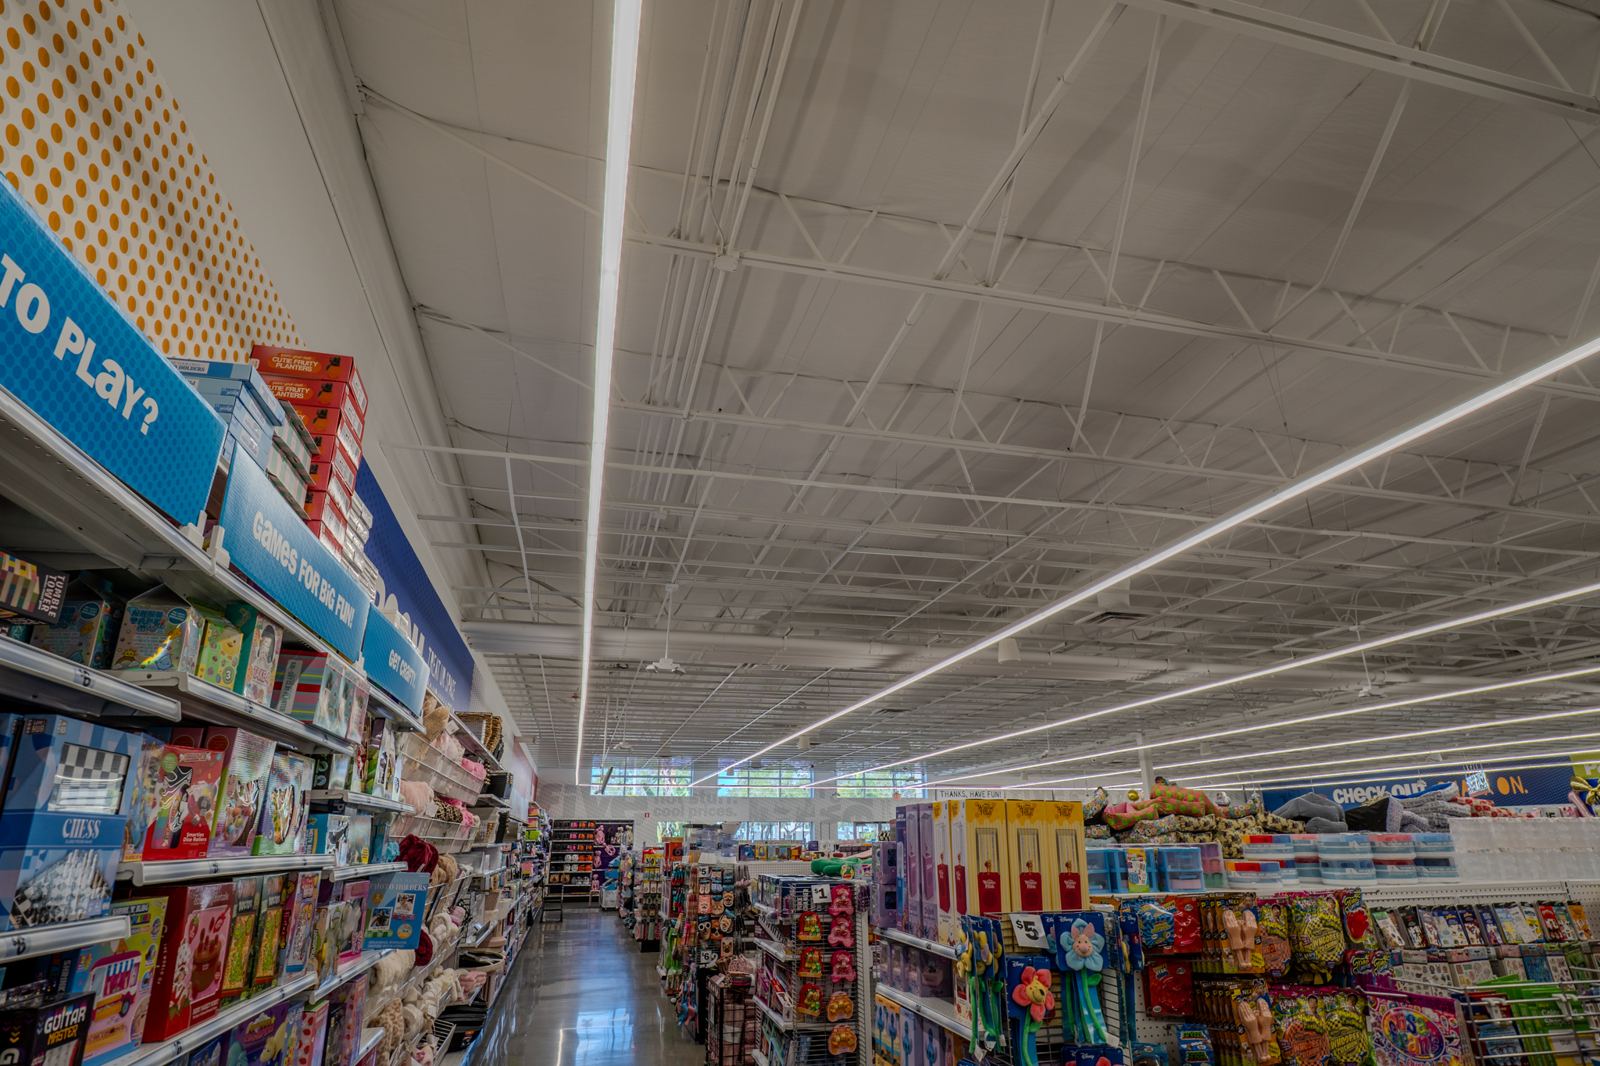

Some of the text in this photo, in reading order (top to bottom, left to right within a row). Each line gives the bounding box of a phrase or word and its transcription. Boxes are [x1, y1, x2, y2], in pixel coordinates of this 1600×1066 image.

[0, 253, 50, 334] TO
[271, 356, 293, 364] CUTIE
[275, 362, 313, 372] PLANTERS
[268, 384, 285, 392] UTIE
[40, 575, 57, 612] TOWER
[48, 575, 65, 618] TUMBLE
[298, 557, 320, 598] FOR
[335, 593, 356, 629] FUN!
[225, 669, 232, 681] 3
[940, 790, 1002, 799] THANKS, HAVE FUN!
[1496, 775, 1529, 796] ON.
[62, 817, 102, 839] CHESS
[814, 887, 828, 899] $1
[1015, 919, 1040, 941] $5
[44, 1006, 87, 1035] GUITAR
[47, 1024, 79, 1046] MASTER
